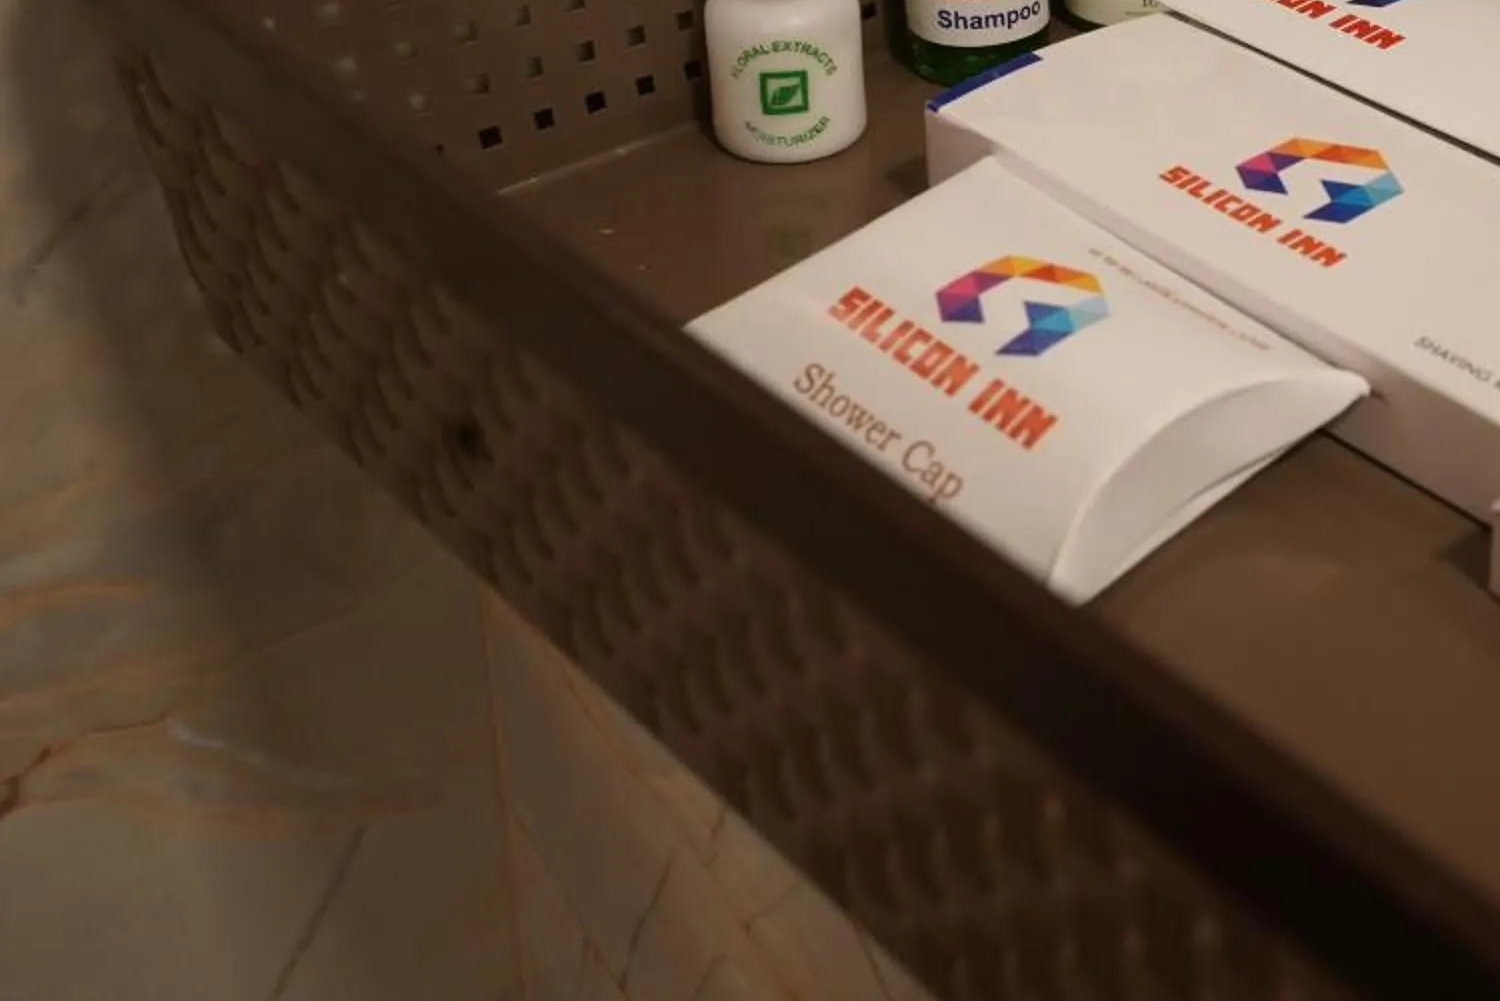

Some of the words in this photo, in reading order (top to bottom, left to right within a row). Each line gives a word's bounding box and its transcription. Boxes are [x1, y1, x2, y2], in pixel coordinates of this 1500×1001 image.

[937, 1, 1041, 29] Shampoo
[1328, 14, 1406, 50] INN
[772, 40, 837, 77] EXTRACTS
[1159, 166, 1282, 234] SILICON
[1276, 228, 1347, 267] INN
[828, 286, 980, 397] SILICON
[967, 378, 1057, 451] INN
[1413, 336, 1495, 383] SHAVING
[793, 362, 902, 452] Shower
[901, 440, 963, 505] Cap
